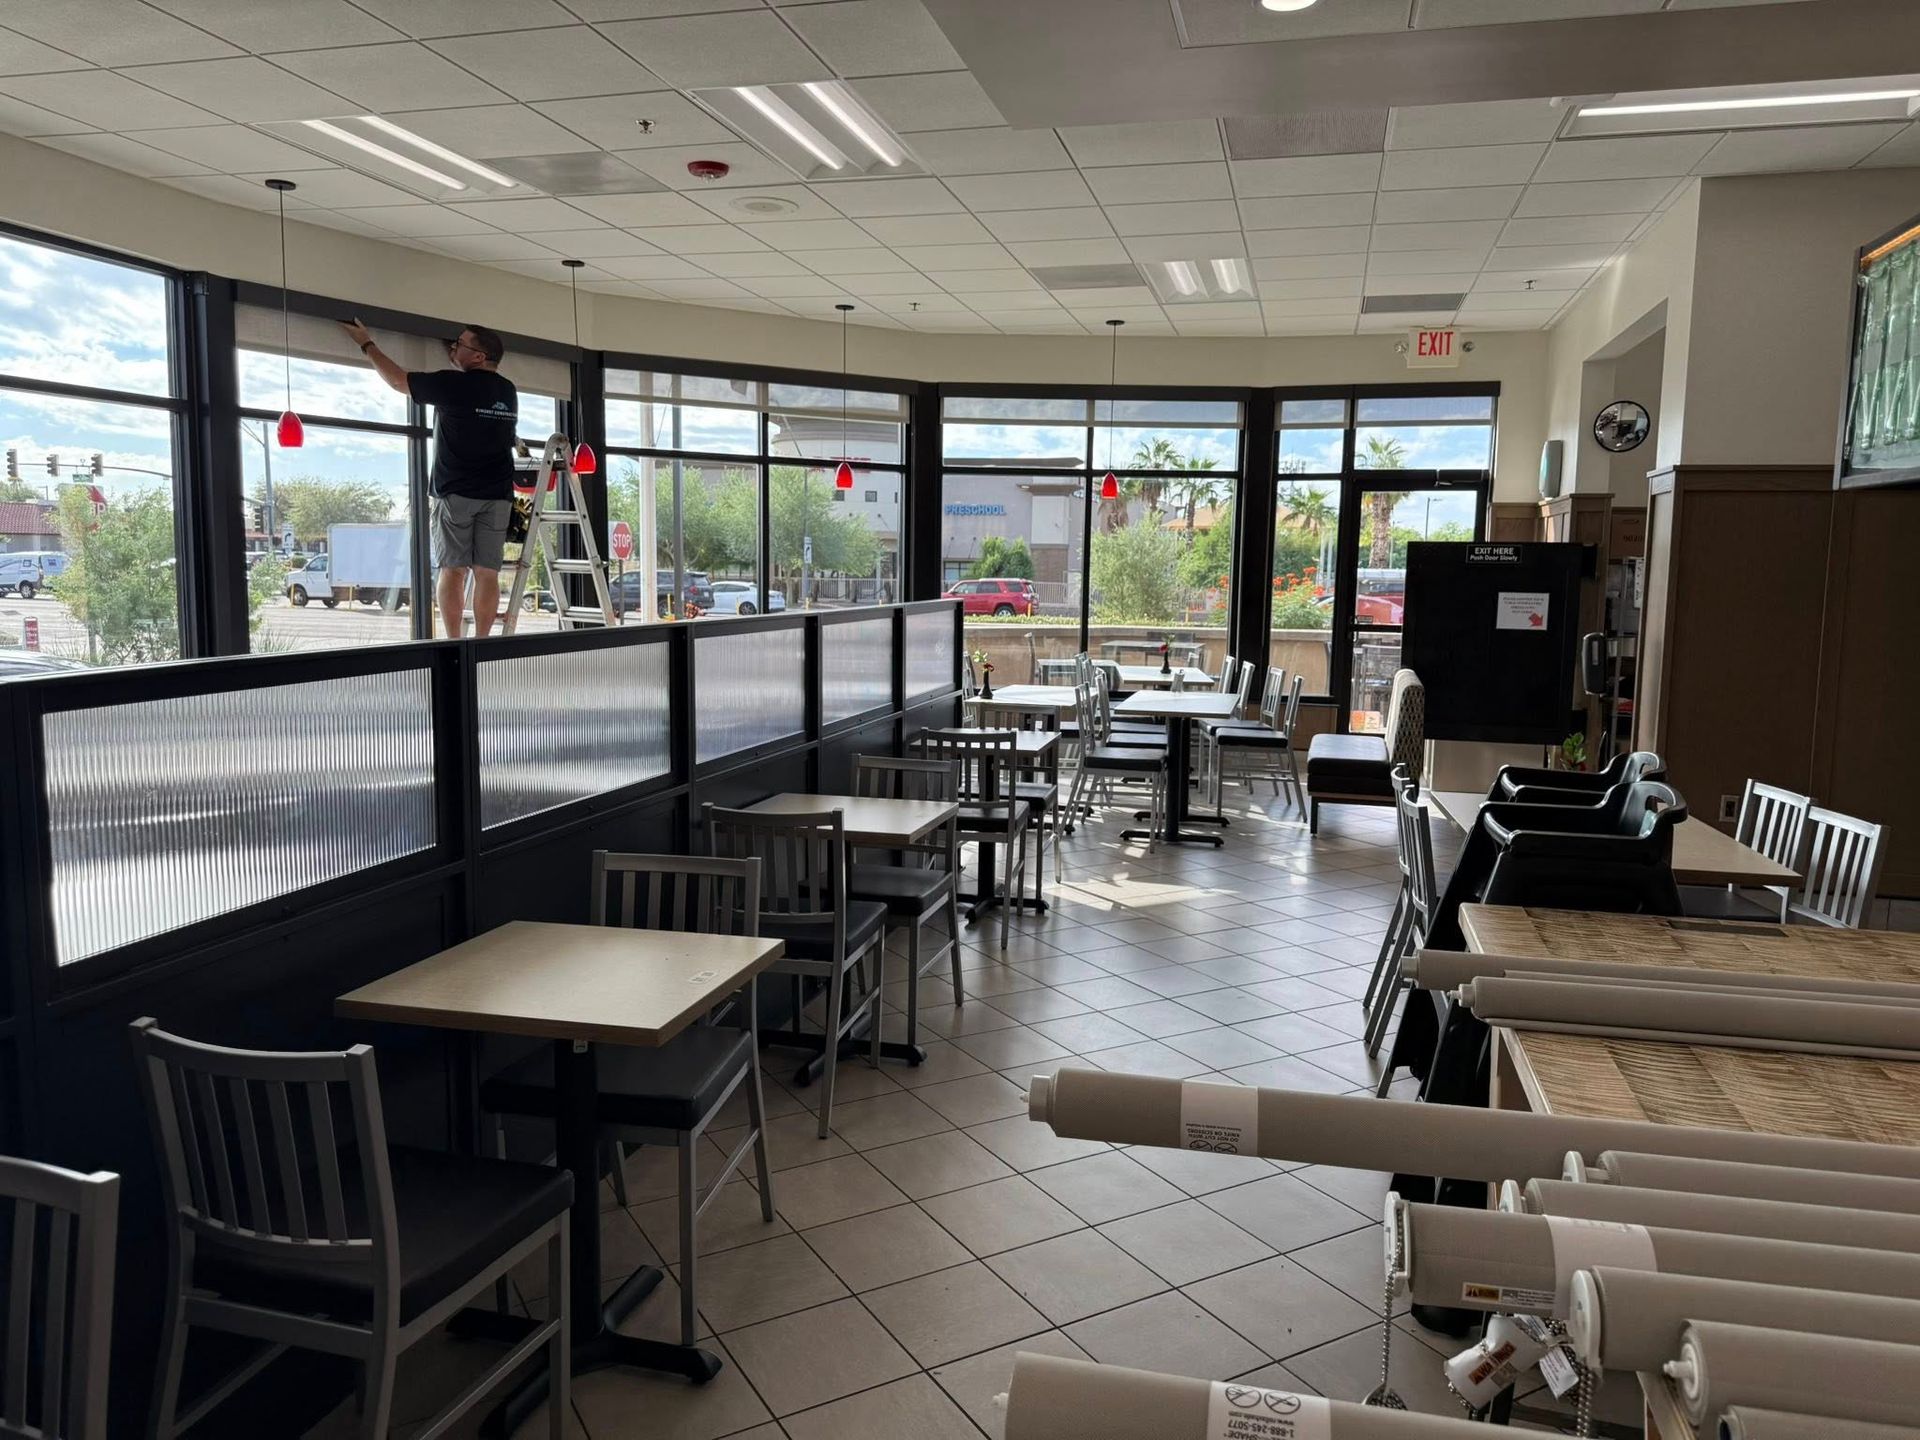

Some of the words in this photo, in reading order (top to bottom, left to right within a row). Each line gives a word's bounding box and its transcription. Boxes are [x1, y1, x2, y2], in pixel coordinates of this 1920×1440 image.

[1418, 331, 1454, 356] EXIT
[944, 504, 1007, 516] PRESCHOOL
[613, 533, 631, 548] STOP
[1474, 547, 1492, 555] EXIT
[1493, 547, 1514, 555] HERE
